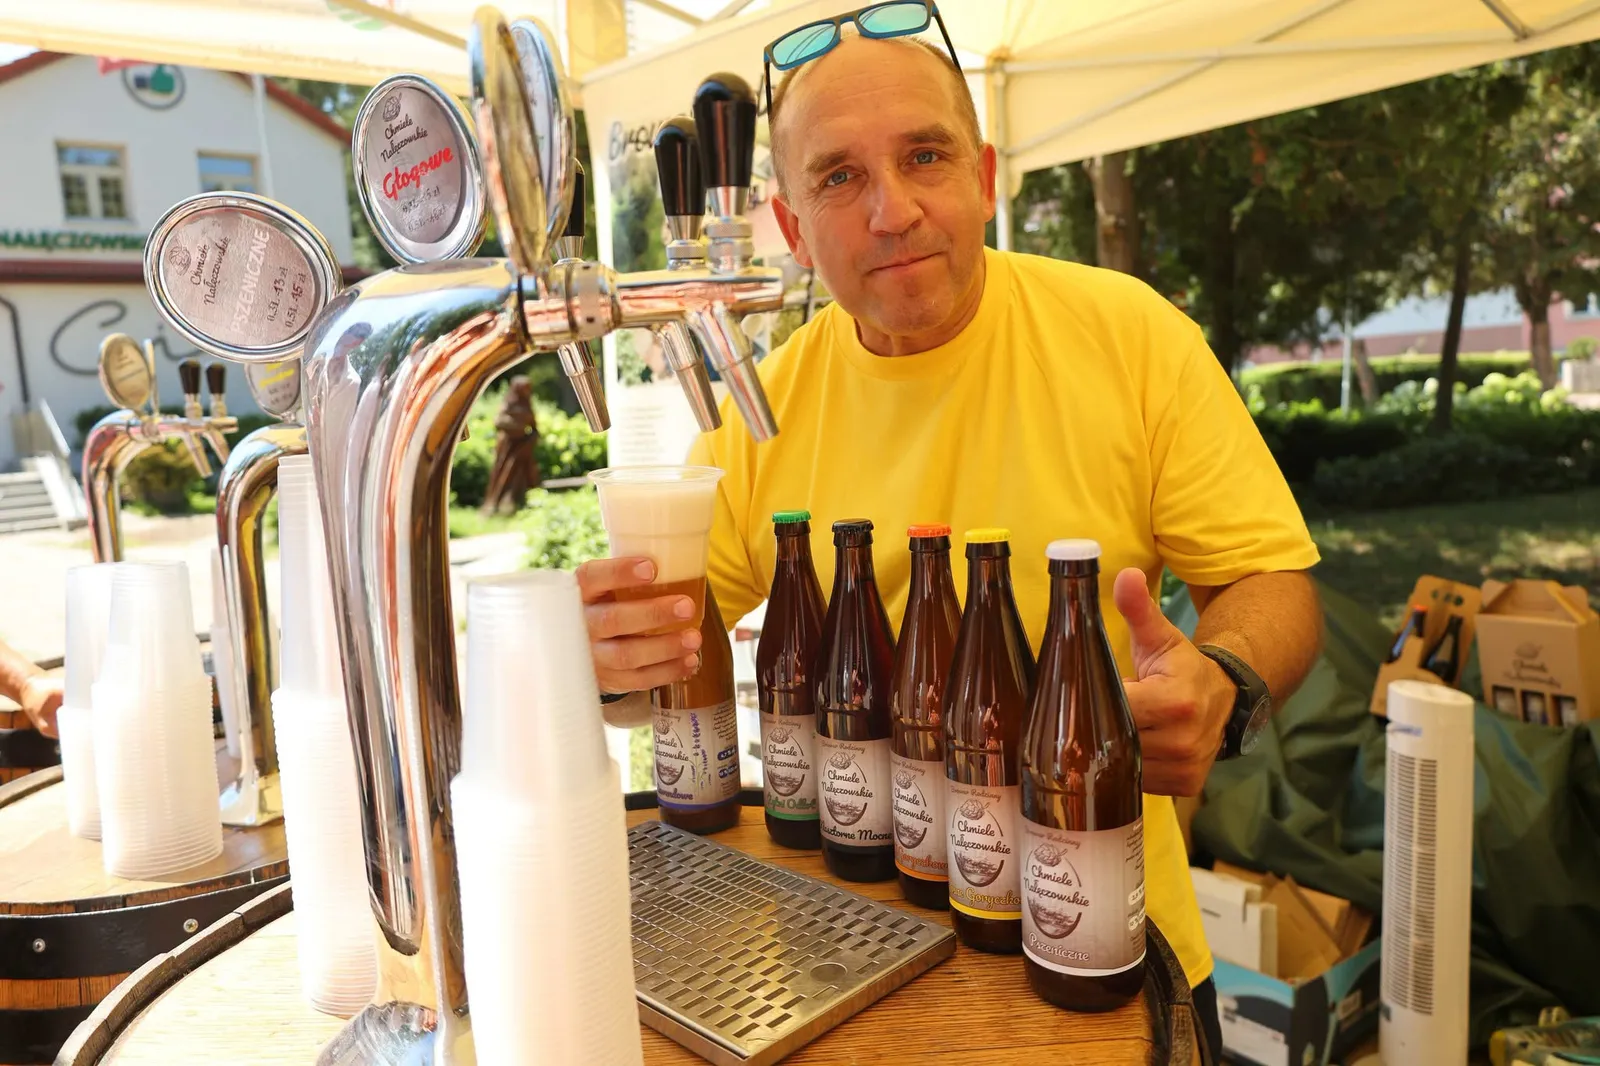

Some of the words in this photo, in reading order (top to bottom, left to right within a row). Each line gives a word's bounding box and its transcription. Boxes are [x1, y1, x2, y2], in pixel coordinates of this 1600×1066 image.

[385, 113, 414, 140] Chmiele
[190, 243, 211, 286] Chmiele
[231, 229, 270, 334] PSZENICZNE
[768, 744, 798, 757] Chmiele
[764, 755, 811, 771] Nałęczowskie
[828, 769, 861, 784] Chmiele
[821, 781, 873, 799] Nałęczowskie
[857, 829, 893, 841] Mocne
[957, 820, 996, 838] Chmiele
[950, 833, 1011, 855] Nałęczowskie
[1031, 864, 1073, 887] Chmiele
[966, 886, 1022, 910] Goryczko
[1023, 875, 1090, 908] Nałęczowskie
[1028, 932, 1090, 962] Pszeniczne
